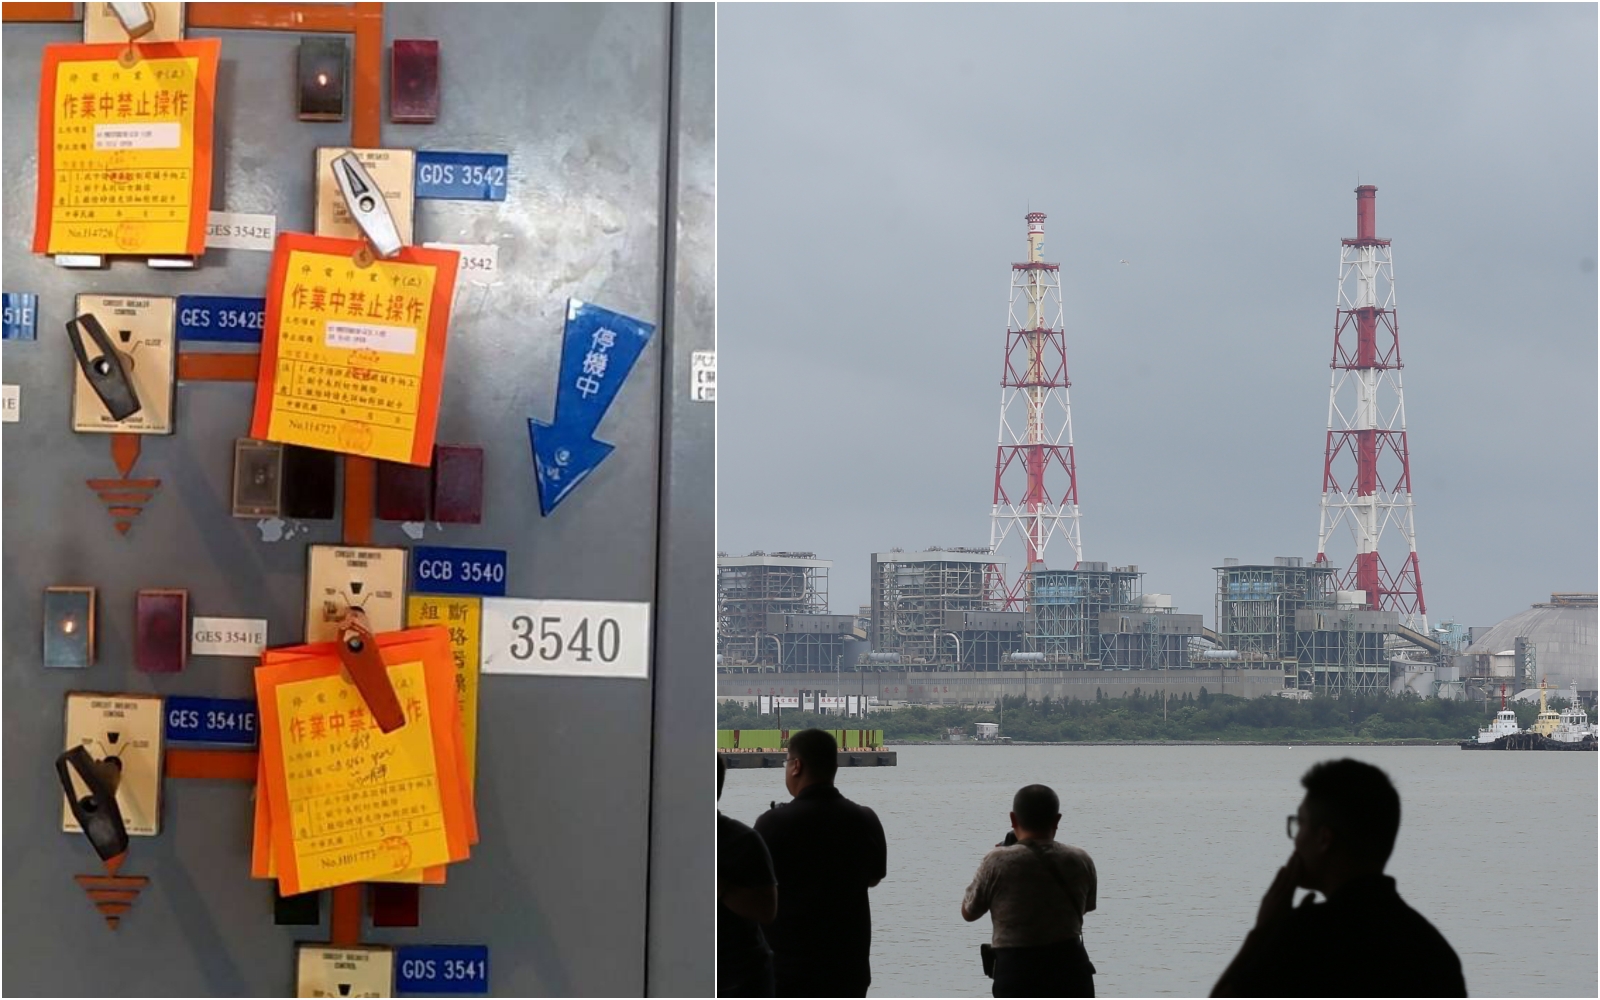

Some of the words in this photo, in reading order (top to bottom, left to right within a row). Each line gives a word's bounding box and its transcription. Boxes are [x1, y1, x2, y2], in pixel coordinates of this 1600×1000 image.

[63, 89, 188, 119] 作業中禁止操作
[420, 165, 454, 184] GDS
[461, 165, 505, 186] 3542
[233, 225, 272, 239] 3542E
[461, 256, 493, 270] 3542
[291, 282, 425, 324] 作業中禁止操作
[181, 308, 210, 328] GES
[218, 309, 265, 330] 3542E
[576, 326, 618, 399] 停機中
[419, 560, 452, 580] GCB
[461, 560, 504, 583] 3540
[195, 630, 222, 643] GES
[226, 631, 263, 645] 3541E
[510, 615, 622, 663] 3540
[169, 708, 199, 728] GES
[206, 710, 255, 732] 3541E
[289, 697, 422, 744] 作業中禁作
[402, 959, 437, 979] GDS
[444, 960, 485, 979] 3541
